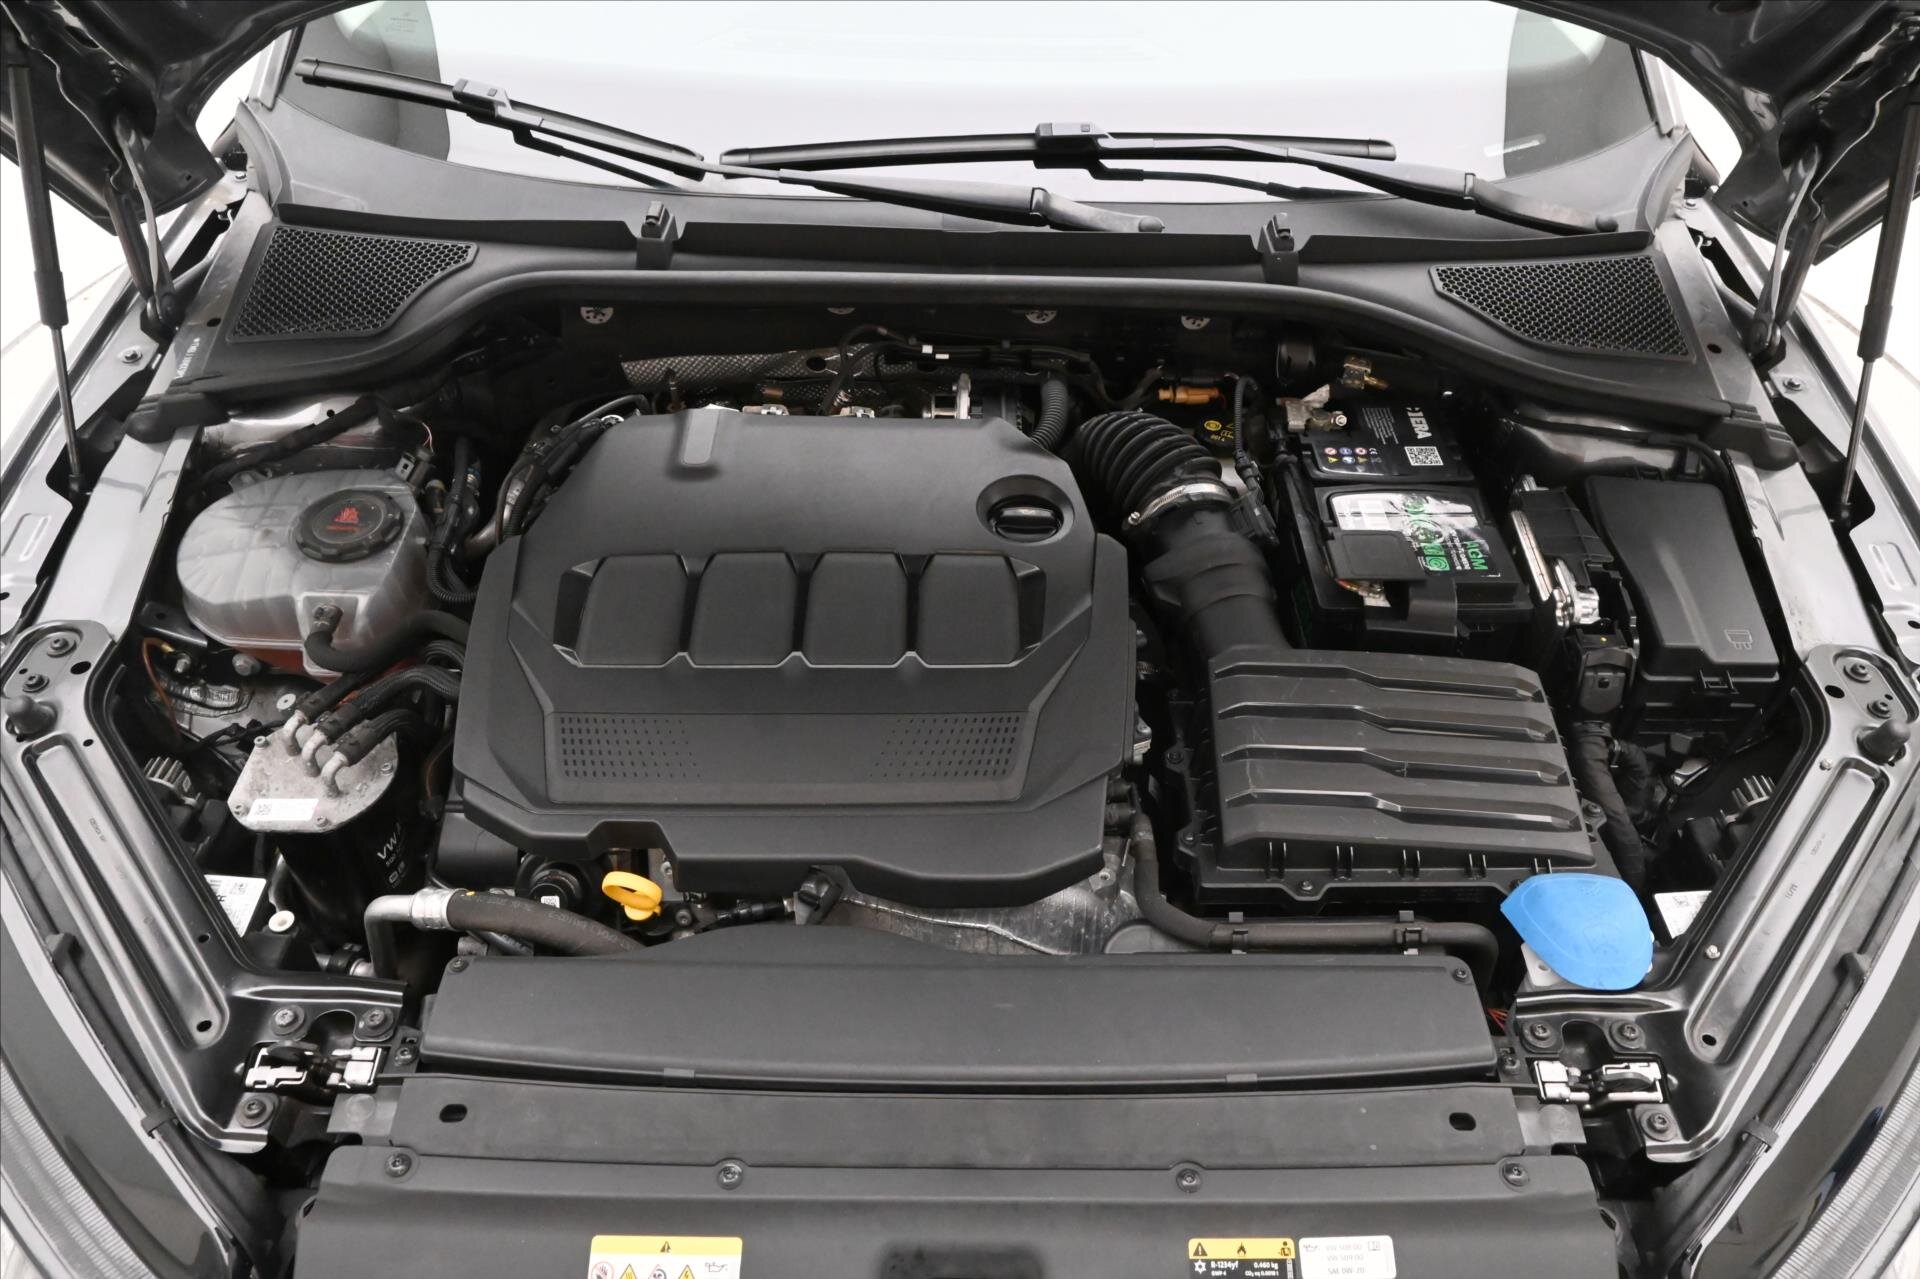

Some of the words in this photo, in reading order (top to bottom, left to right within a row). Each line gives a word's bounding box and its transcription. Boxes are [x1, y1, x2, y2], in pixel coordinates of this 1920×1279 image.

[1464, 540, 1489, 571] AGM
[377, 831, 397, 859] VW
[1210, 1261, 1239, 1270] R-1234yf
[1271, 1262, 1279, 1270] kg
